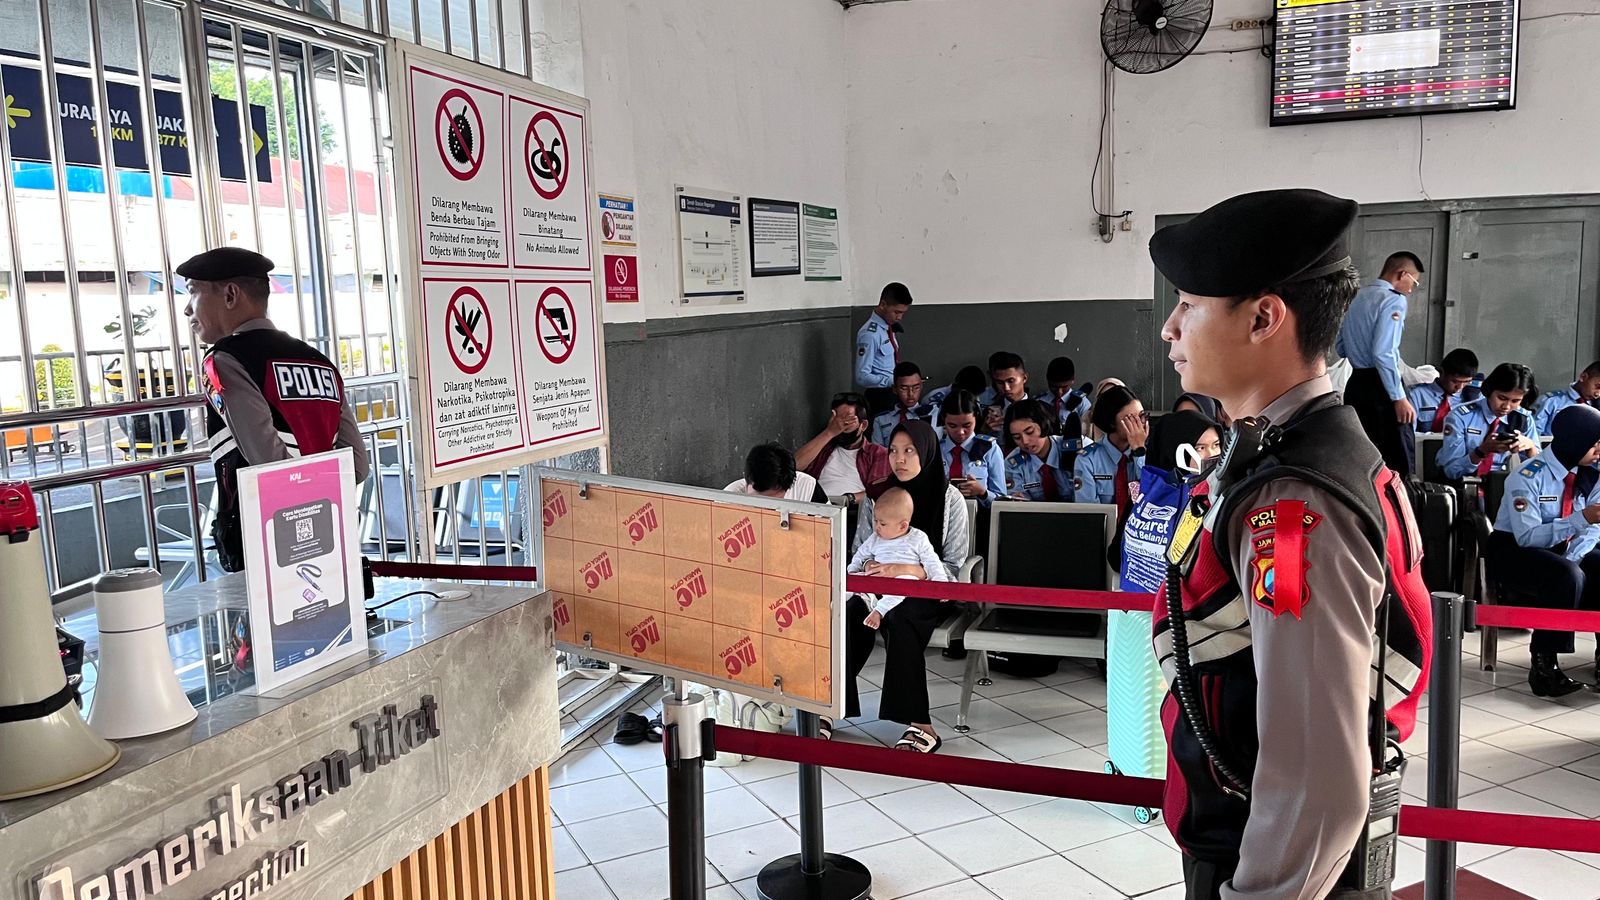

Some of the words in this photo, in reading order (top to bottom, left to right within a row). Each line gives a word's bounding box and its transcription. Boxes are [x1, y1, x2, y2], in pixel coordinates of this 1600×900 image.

[431, 196, 460, 212] Dilarang
[461, 200, 494, 214] Membawa
[431, 211, 451, 224] Benda
[453, 214, 475, 227] Berbau
[477, 217, 496, 230] Tajam
[523, 207, 548, 222] Dilarang
[548, 211, 577, 223] Membawa
[429, 231, 460, 244] Prohibited
[460, 233, 475, 244] From
[476, 235, 499, 248] Bringing
[538, 224, 564, 238] Binatang
[429, 245, 451, 259] Objects
[452, 247, 467, 257] With
[467, 248, 486, 260] Strong
[487, 250, 500, 259] Odor
[526, 242, 535, 252] No
[558, 245, 580, 255] Allowed
[443, 379, 473, 394] Dilarang
[474, 376, 507, 388] Membawa
[534, 379, 558, 392] Dilarang
[558, 376, 587, 388] Membawa
[437, 395, 475, 409] Narkotika,
[475, 388, 516, 402] Psikotropika
[532, 394, 554, 405] Senjata
[555, 391, 569, 401] Jenis
[570, 387, 591, 400] Apapun
[439, 413, 453, 424] dan
[454, 411, 466, 421] zat
[467, 406, 490, 419] adiktif
[491, 402, 517, 416] lainnya
[560, 408, 567, 419] Of
[567, 406, 578, 418] Any
[578, 404, 590, 414] Kind
[552, 418, 578, 431] Prohibited
[447, 438, 463, 449] Other
[463, 434, 486, 446] Addictive
[495, 428, 513, 440] Strictly
[470, 442, 495, 454] Prohibited
[352, 694, 441, 774] Tiket
